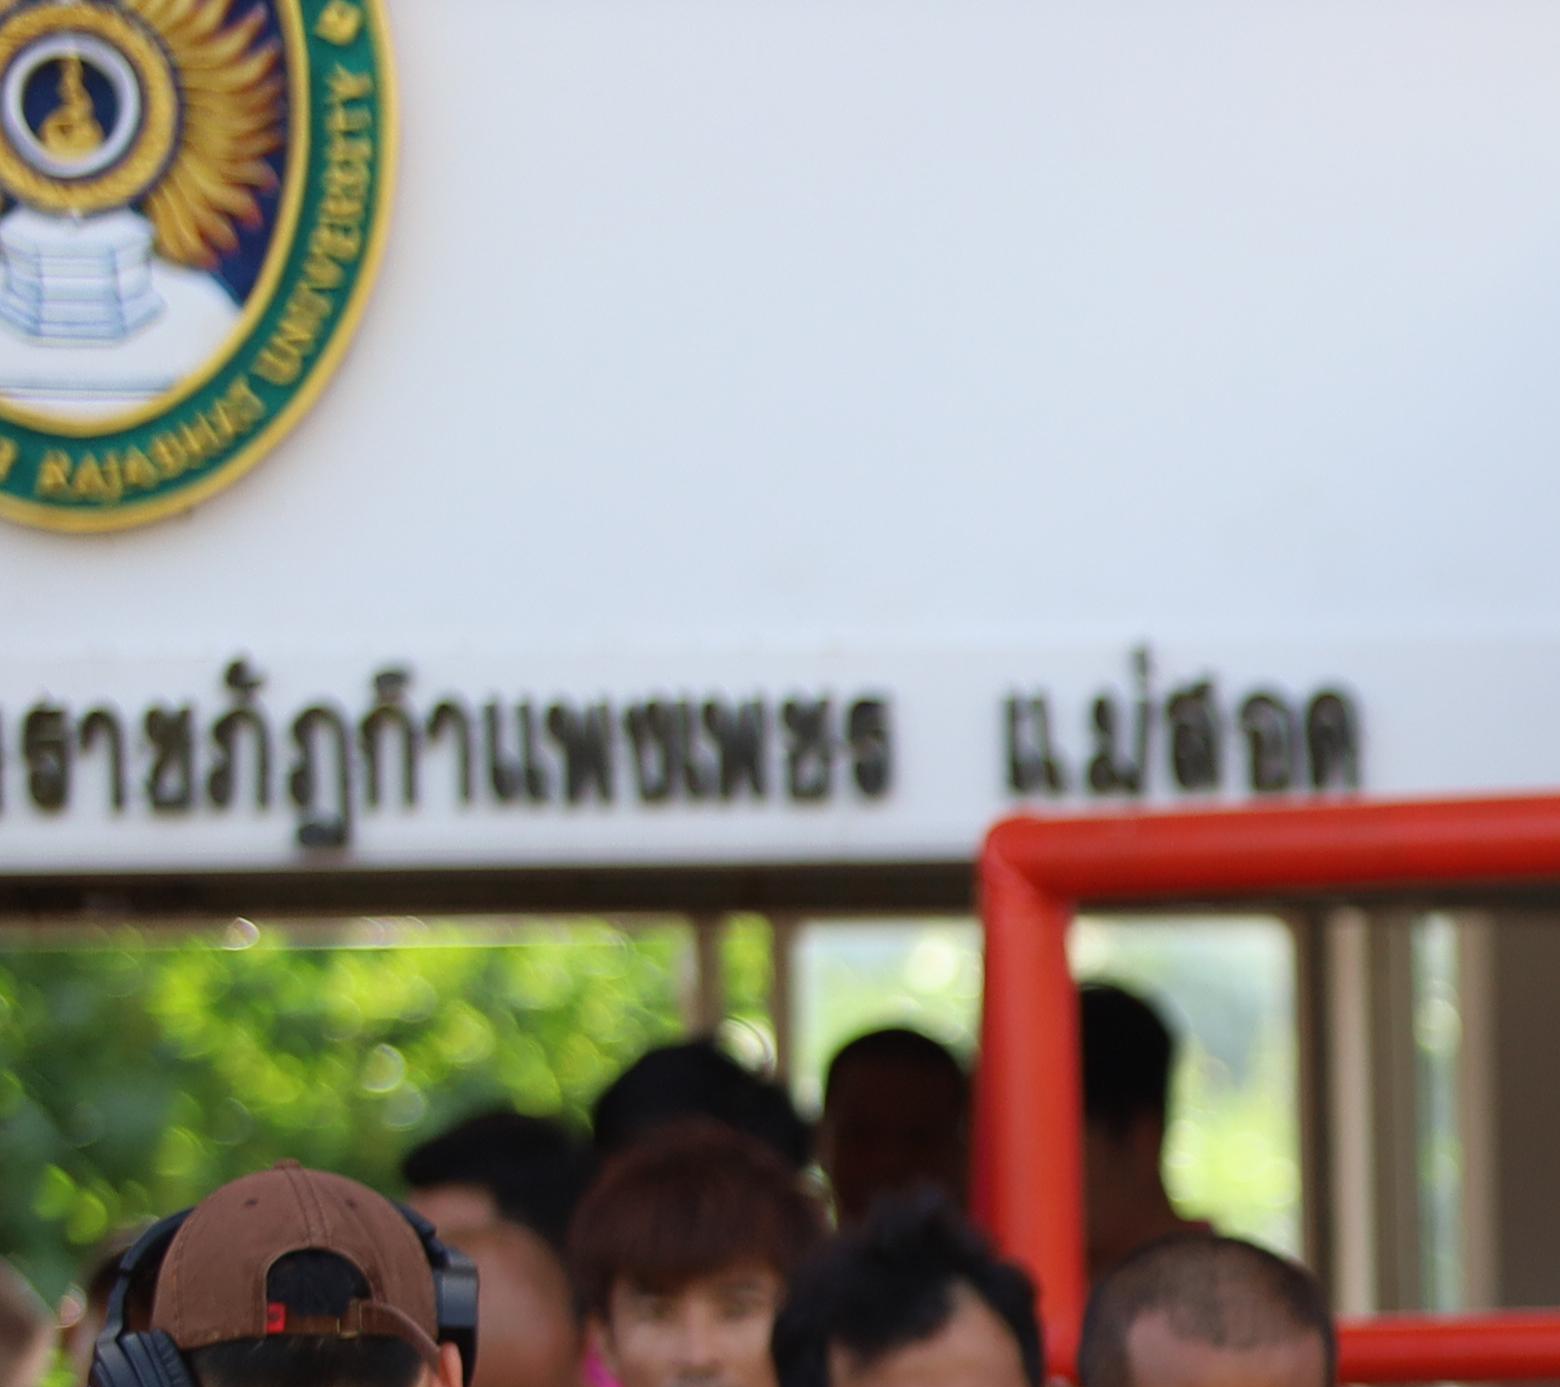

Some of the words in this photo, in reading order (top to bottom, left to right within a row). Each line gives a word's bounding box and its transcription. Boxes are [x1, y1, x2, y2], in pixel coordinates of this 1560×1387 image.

[35, 374, 268, 502] RAJABHAT
[252, 62, 376, 388] UNIVERSITY
[0, 655, 892, 850] ราชภัฏกำแพงเพชร
